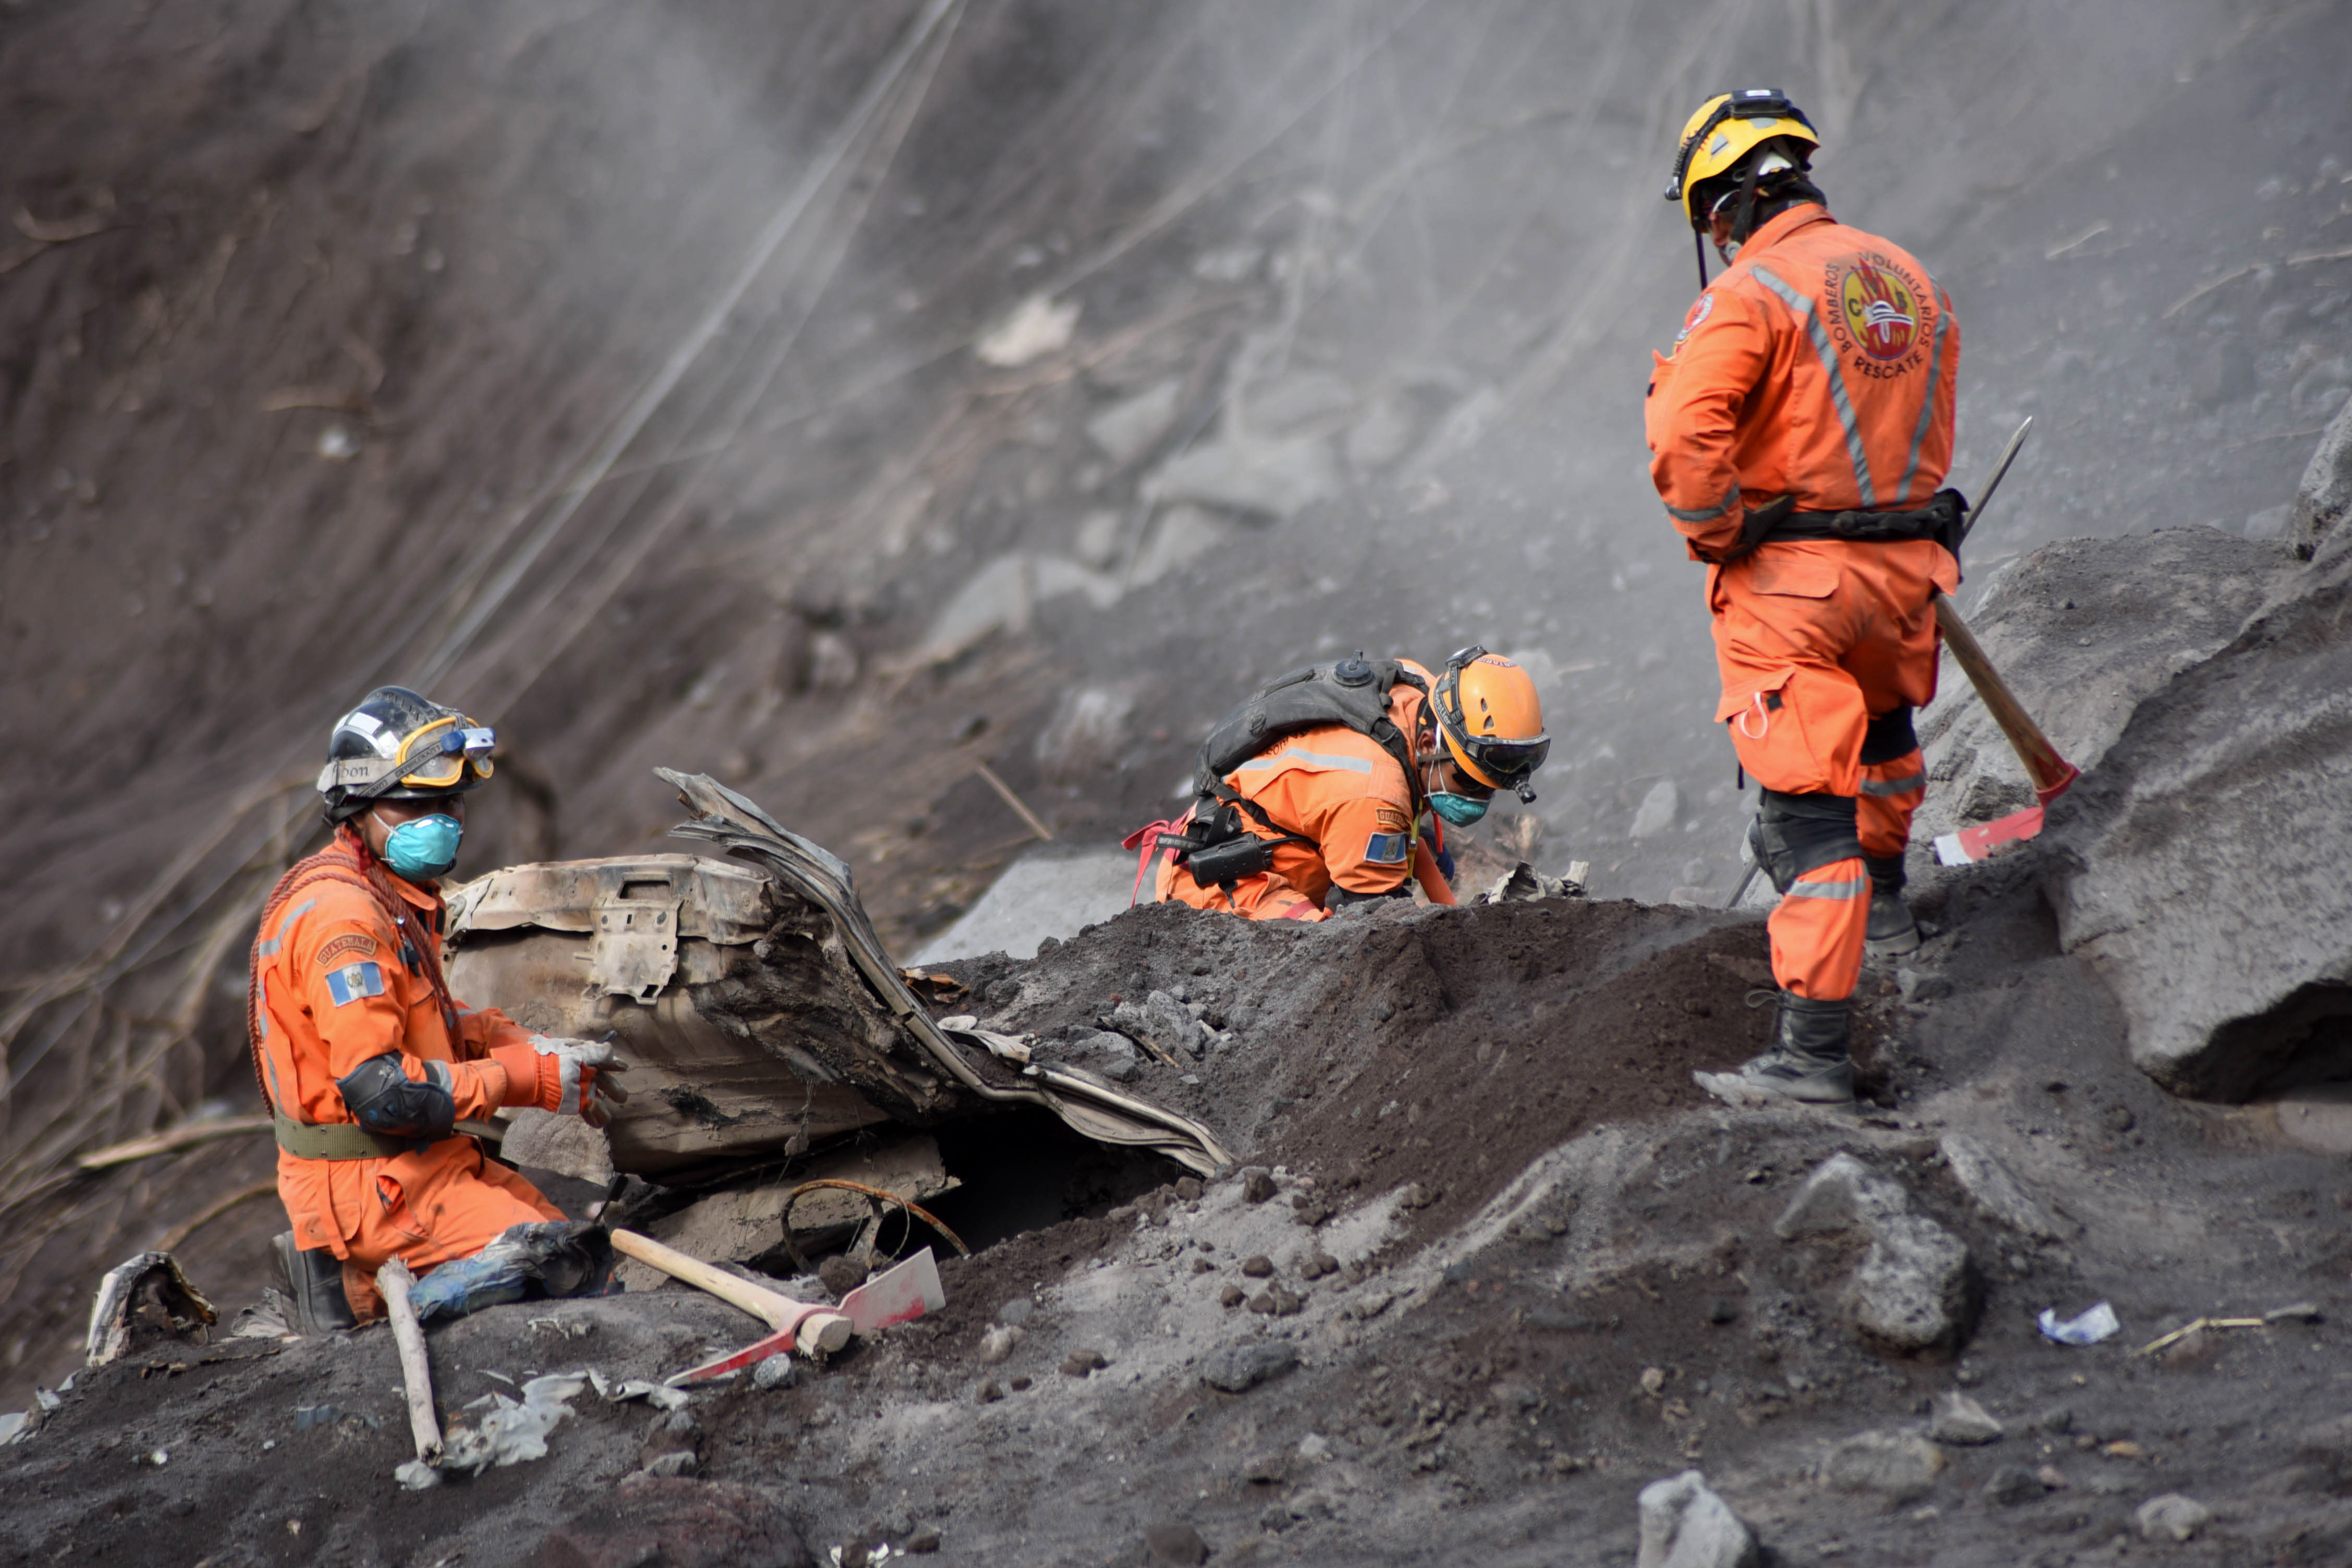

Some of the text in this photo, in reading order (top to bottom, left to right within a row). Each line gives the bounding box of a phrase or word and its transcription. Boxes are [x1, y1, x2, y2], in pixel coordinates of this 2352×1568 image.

[1824, 262, 1853, 353] BOMBEROS
[1856, 251, 1933, 348] VOLUNTARIOS
[1854, 350, 1923, 379] RESCATE
[319, 937, 373, 963] GUATEMALA
